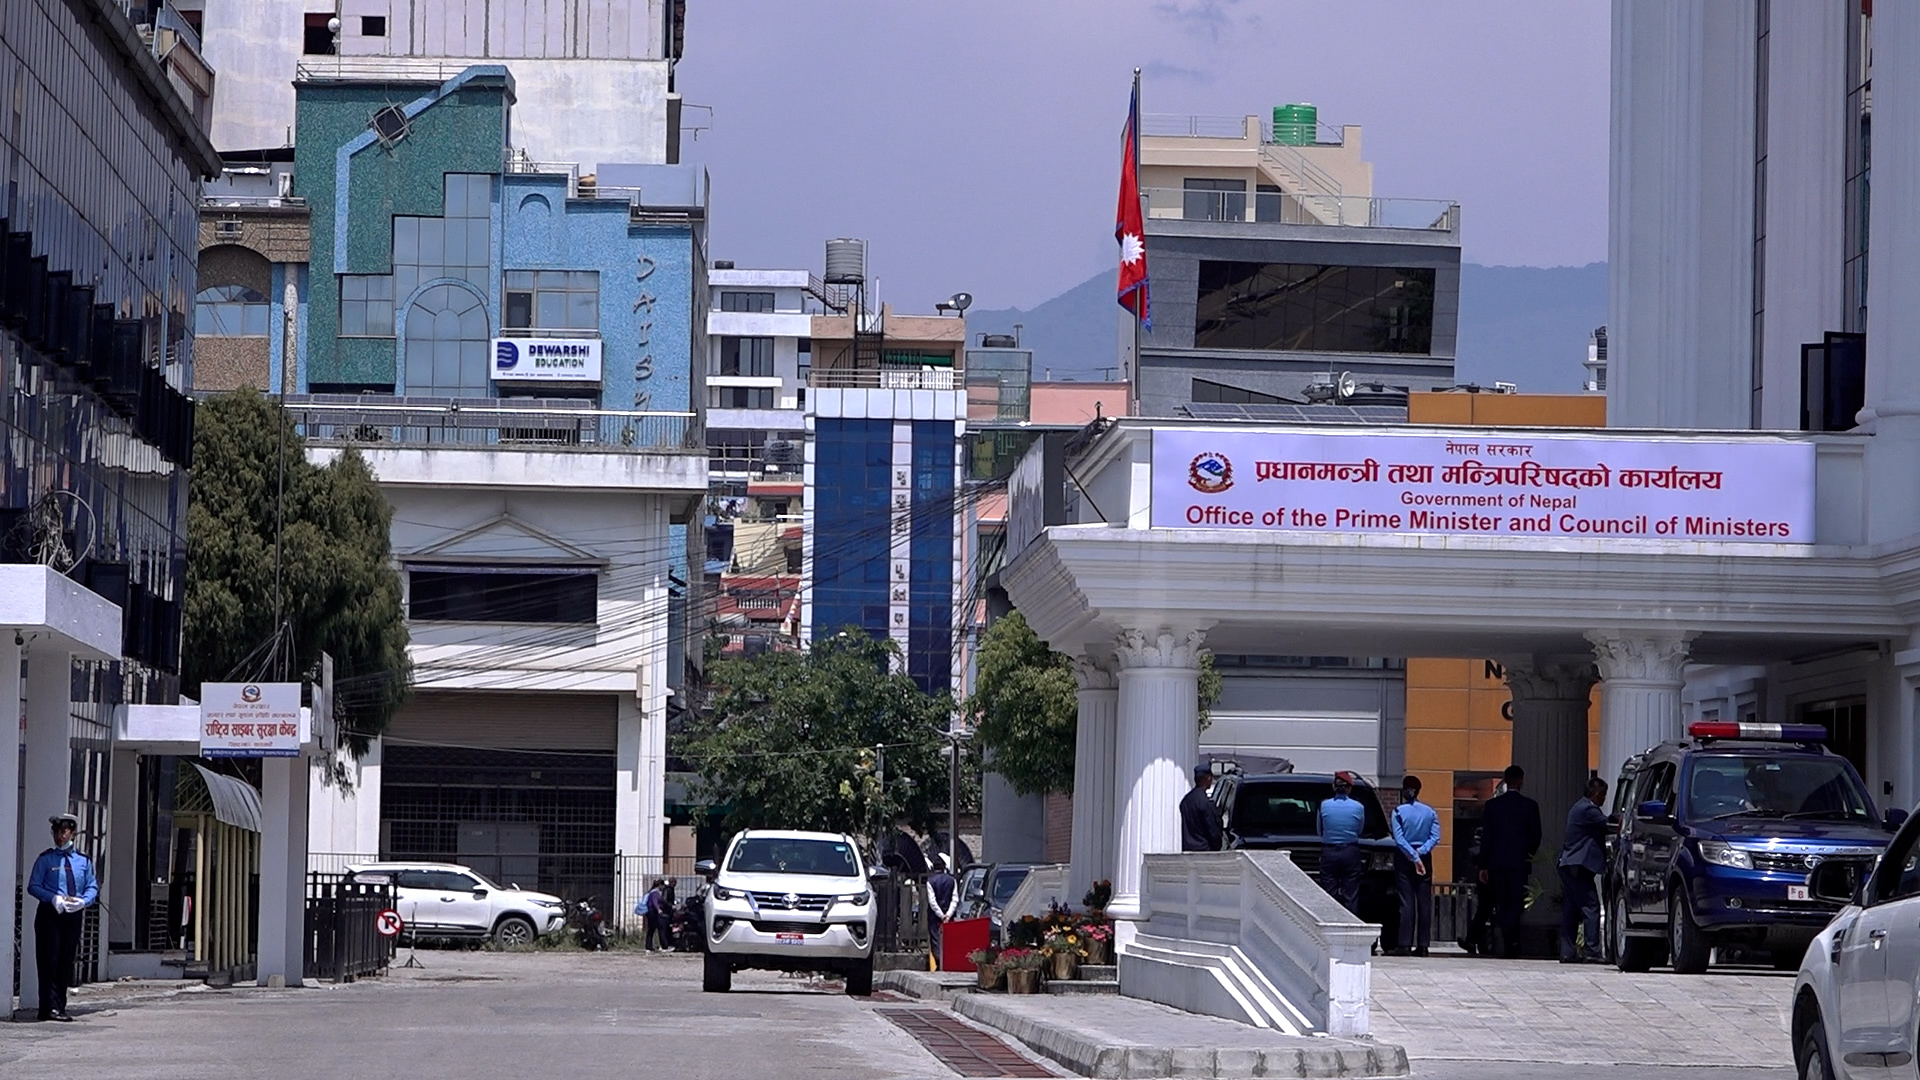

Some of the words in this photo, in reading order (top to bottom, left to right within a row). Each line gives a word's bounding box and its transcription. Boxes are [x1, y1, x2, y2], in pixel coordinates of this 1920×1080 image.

[529, 345, 590, 357] DEWARSHI
[535, 358, 585, 369] EDUCATION
[1446, 440, 1480, 455] नेपाल
[1487, 444, 1534, 458] सरकार
[1255, 458, 1381, 483] प्रधानमन्त्री
[1388, 465, 1434, 484] तथा
[1442, 460, 1612, 490] मन्त्रिपरिषदको
[1619, 466, 1723, 490] कार्यालय
[1401, 491, 1503, 507] Government
[1508, 494, 1525, 507] of
[1530, 494, 1577, 511] Nepal
[1187, 505, 1254, 525] Office
[1262, 507, 1286, 525] of
[1291, 508, 1327, 526] the
[1336, 509, 1402, 528] Prime
[1410, 511, 1503, 531] Minister
[1509, 513, 1551, 532] and
[1559, 514, 1647, 534] Council
[1655, 516, 1679, 535] of
[1685, 516, 1790, 537] Ministers
[231, 723, 255, 737] साइबर
[257, 723, 277, 739] सुरक्षा
[279, 720, 297, 738] केन्द्र
